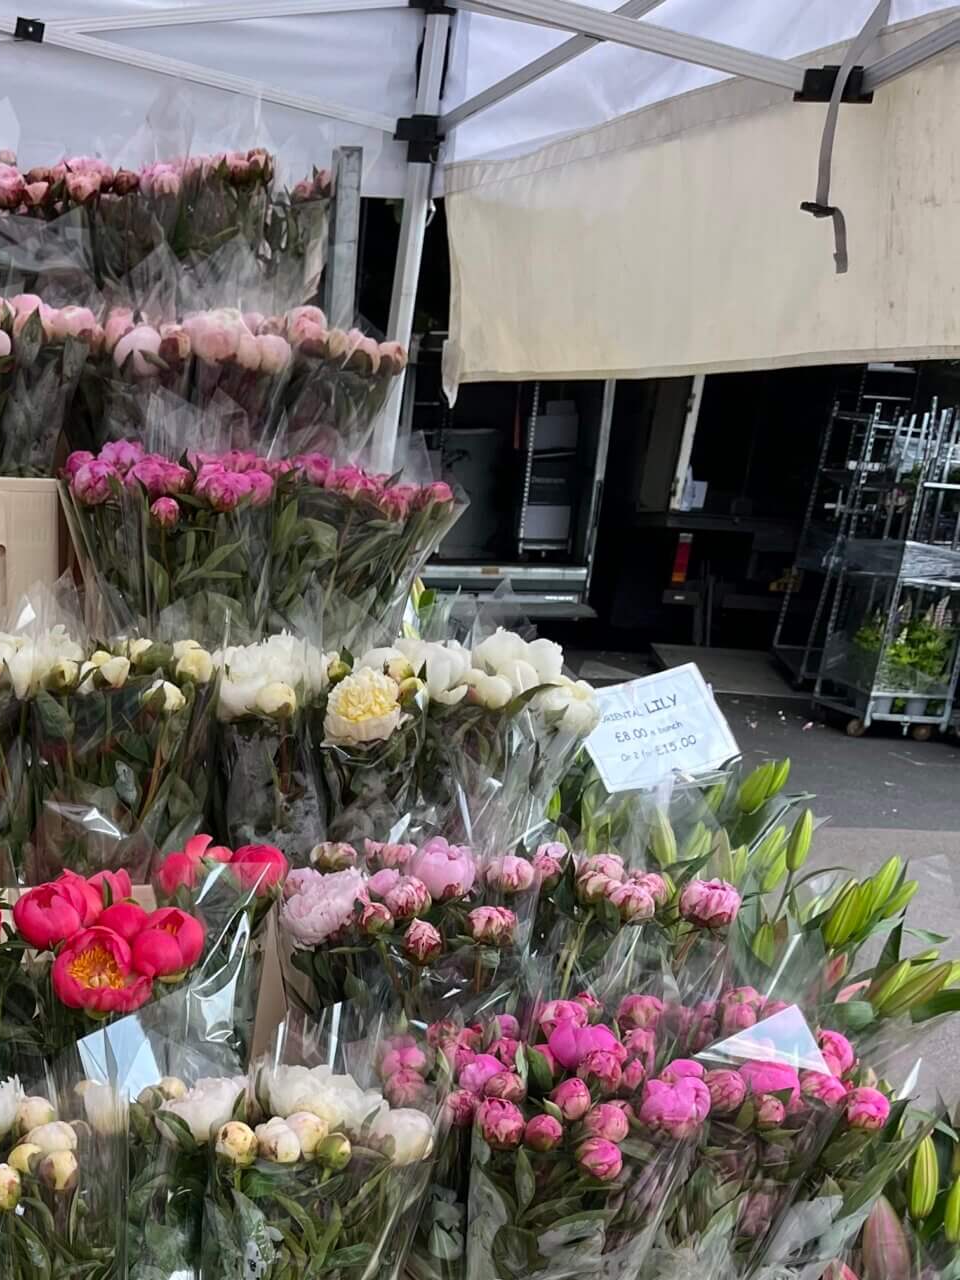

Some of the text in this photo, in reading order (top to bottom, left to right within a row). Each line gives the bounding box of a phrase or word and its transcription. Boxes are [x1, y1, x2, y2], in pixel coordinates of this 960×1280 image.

[644, 693, 677, 714] LILY
[615, 728, 648, 743] £8.00
[655, 734, 697, 756] £15.00
